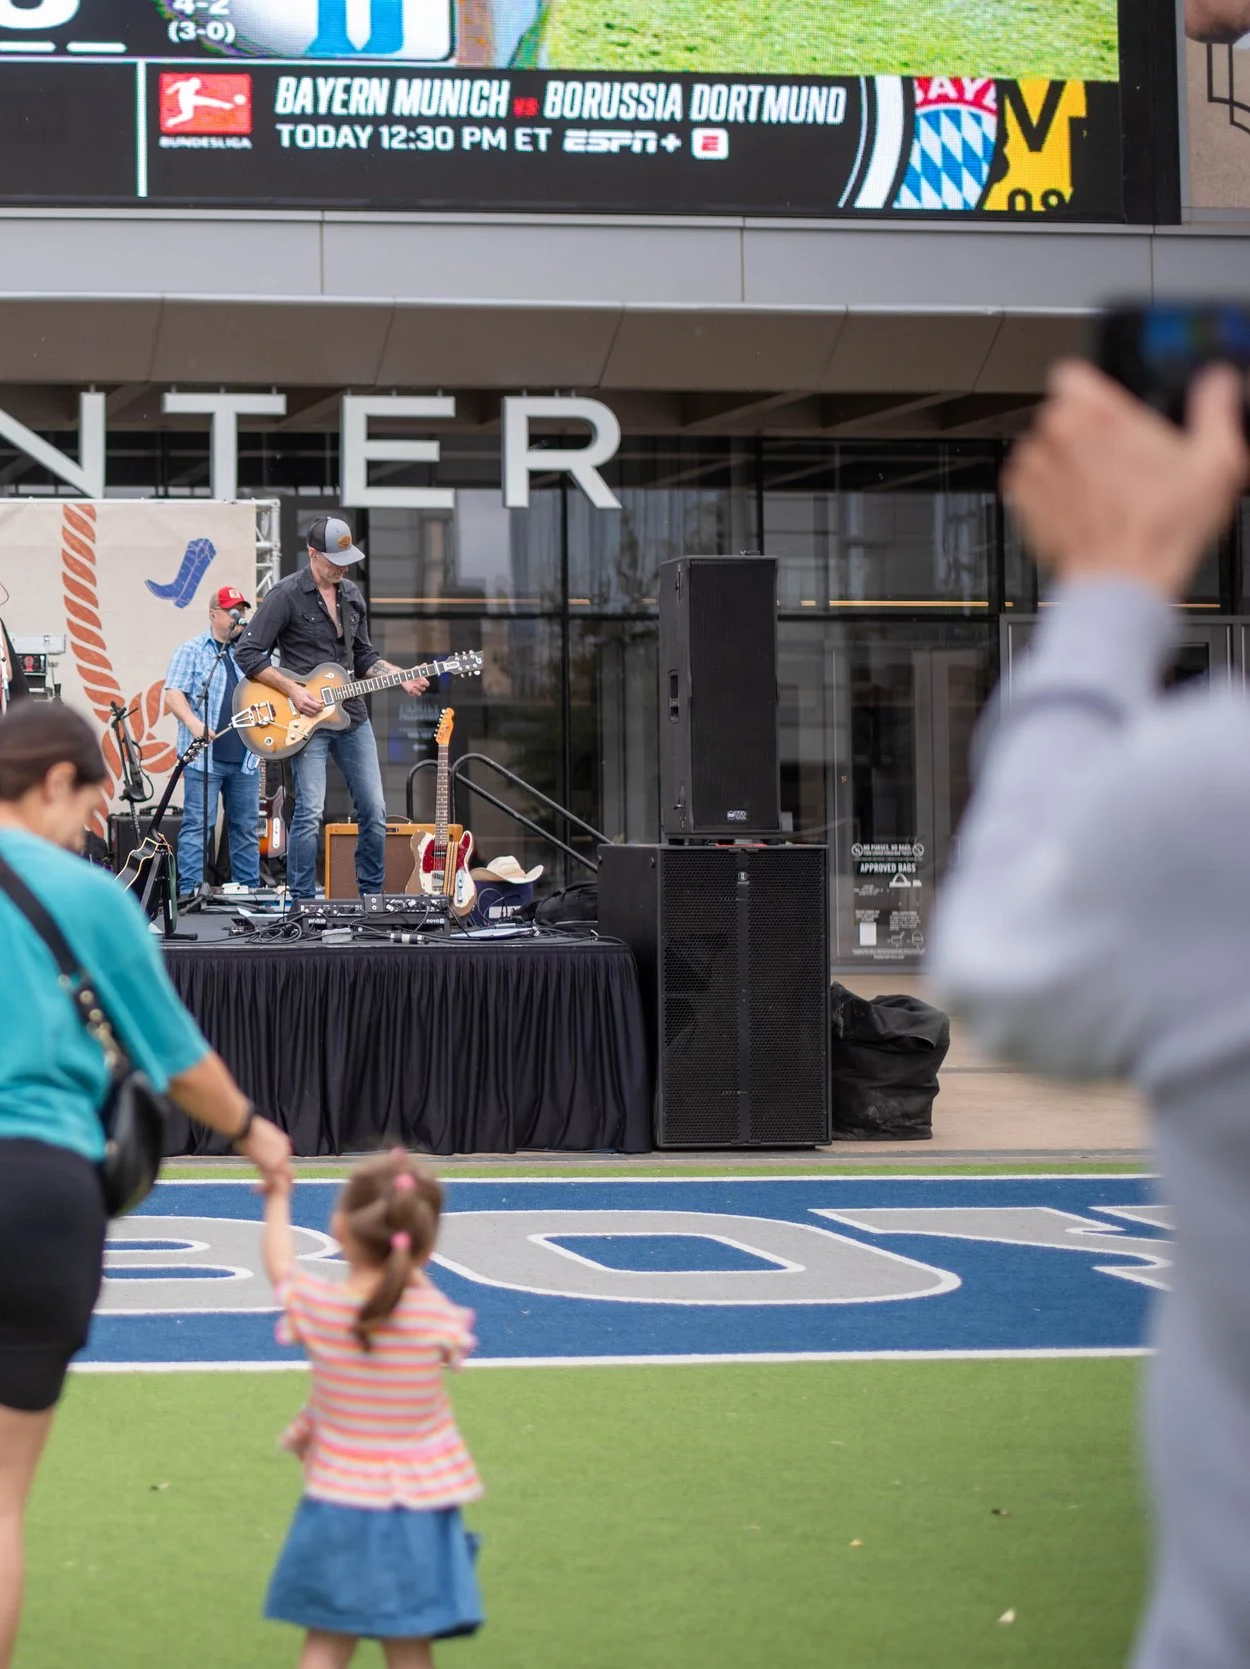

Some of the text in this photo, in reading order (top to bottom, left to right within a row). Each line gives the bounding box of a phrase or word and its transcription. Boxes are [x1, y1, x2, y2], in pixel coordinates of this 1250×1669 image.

[168, 20, 236, 44] (3-0)
[274, 76, 390, 116] BAYERN
[393, 78, 511, 118] MUNICH
[543, 80, 682, 120] BORUSSIA
[689, 83, 847, 125] DORTMUND
[159, 136, 252, 149] BUNDESLIGA
[275, 123, 373, 149] TODAY
[378, 124, 454, 150] 12:30
[461, 126, 507, 151] PM
[513, 127, 552, 152] ET
[860, 862, 896, 873] APPROVED
